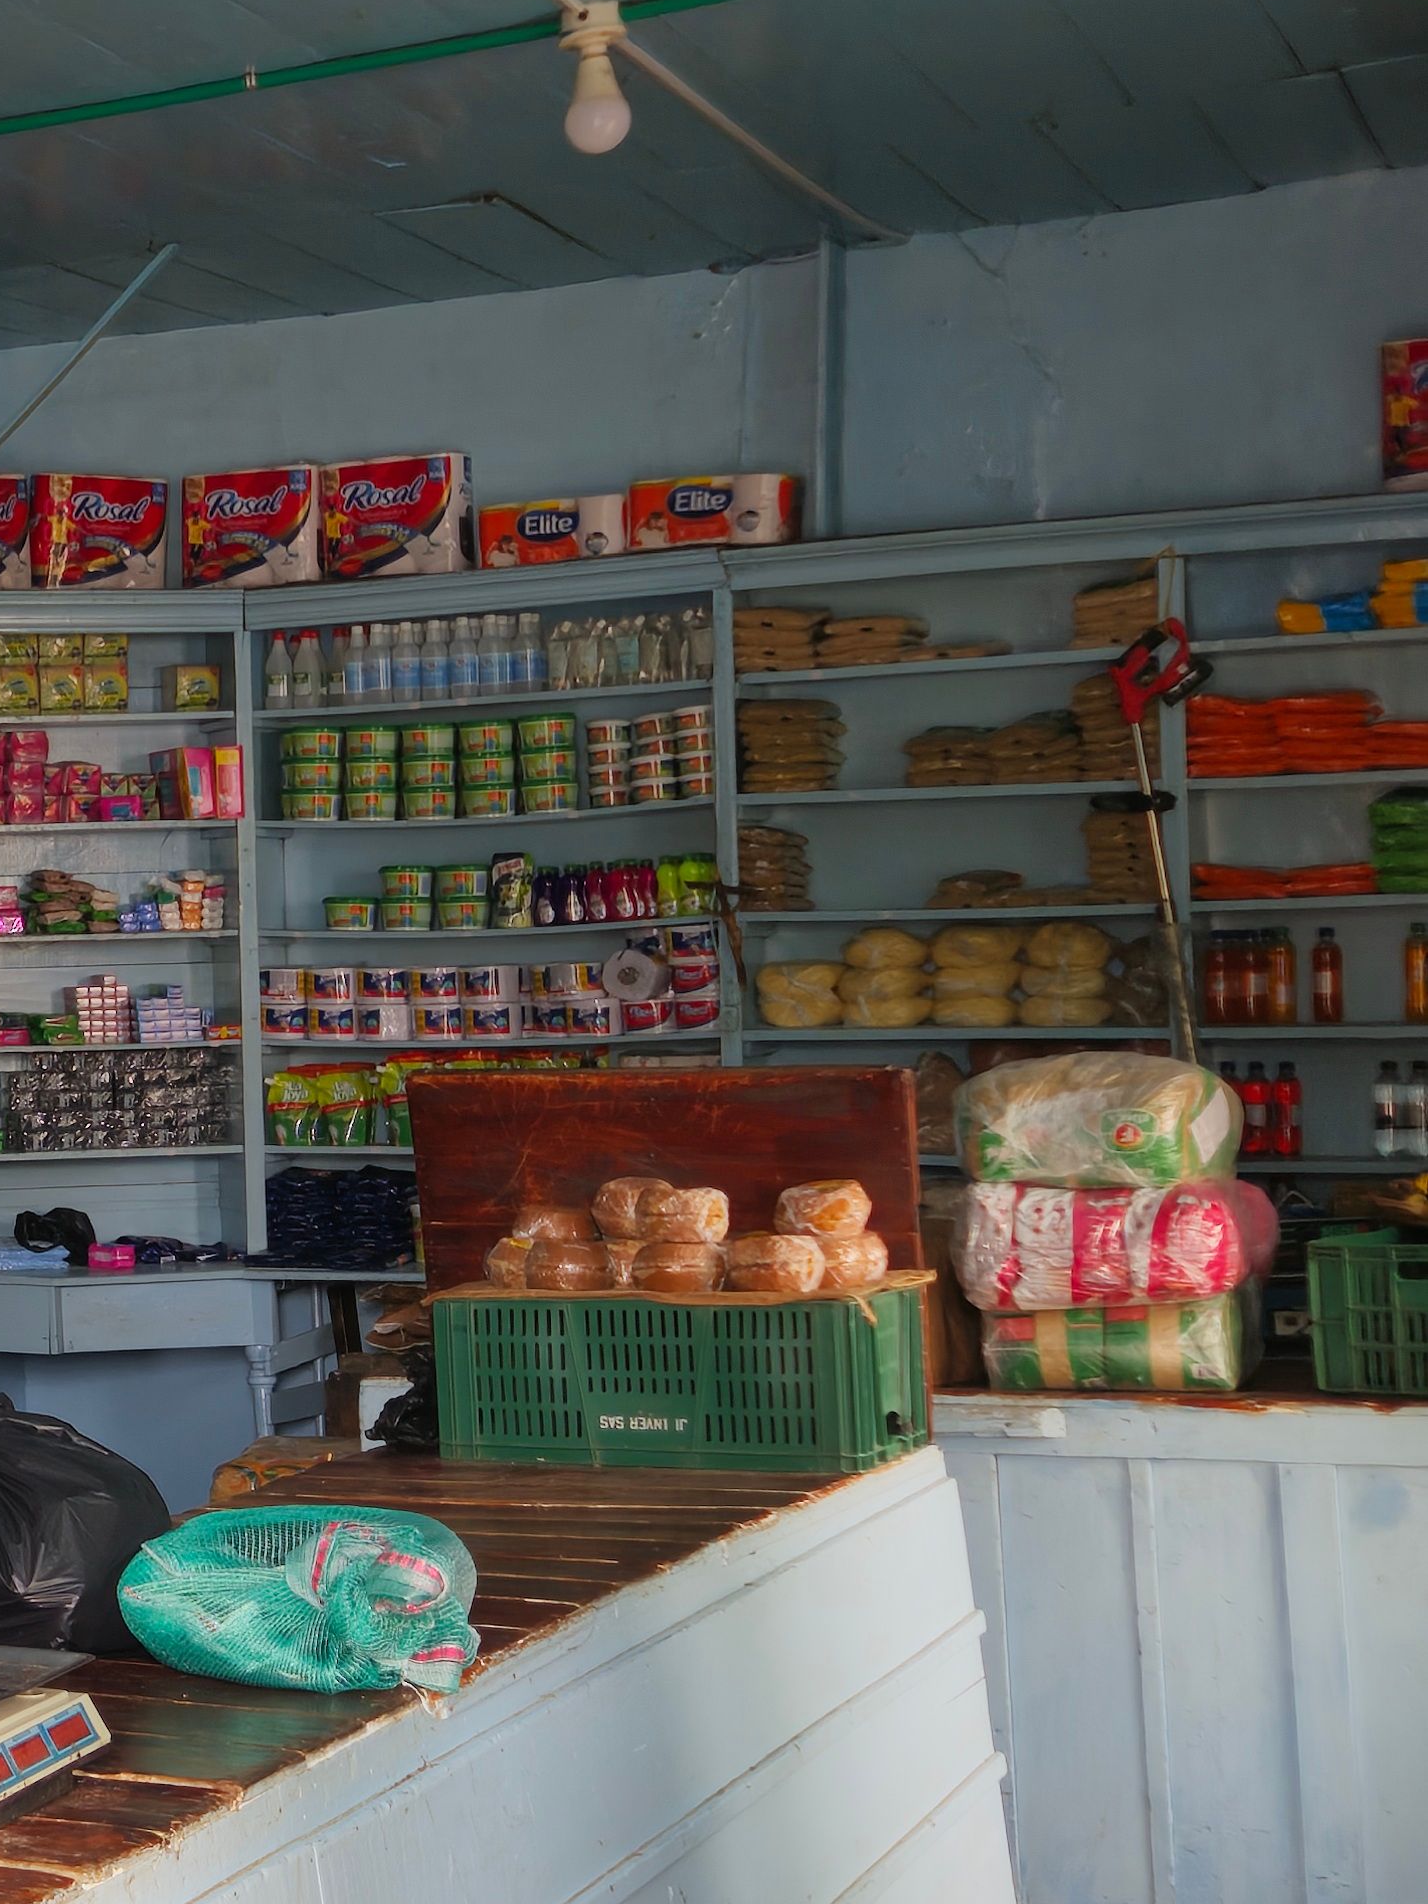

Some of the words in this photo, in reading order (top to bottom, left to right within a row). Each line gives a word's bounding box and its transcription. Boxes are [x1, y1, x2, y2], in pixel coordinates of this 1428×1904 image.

[206, 485, 288, 520] Rosal
[340, 474, 427, 513] Rosal
[675, 490, 726, 513] Elite
[72, 492, 150, 524] Rosal
[524, 514, 573, 536] Elite
[599, 1415, 625, 1430] SAS
[629, 1415, 668, 1431] INVER
